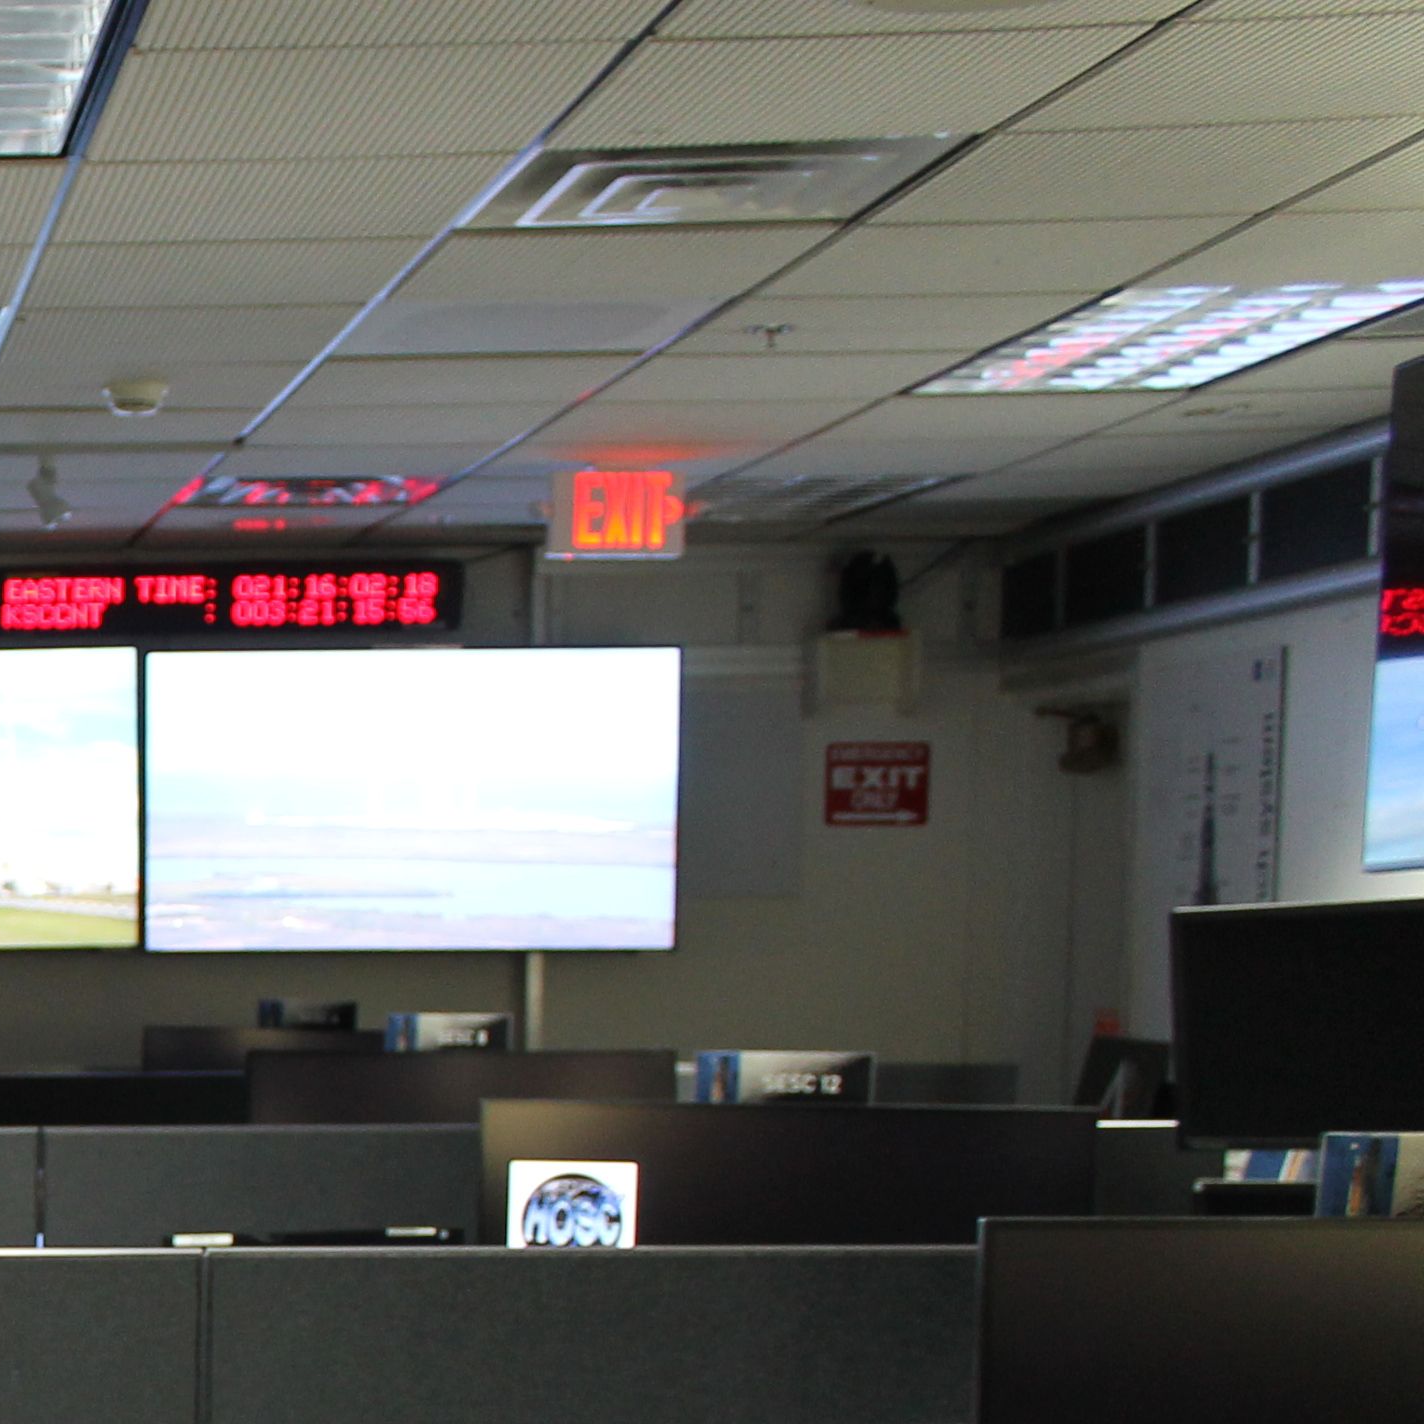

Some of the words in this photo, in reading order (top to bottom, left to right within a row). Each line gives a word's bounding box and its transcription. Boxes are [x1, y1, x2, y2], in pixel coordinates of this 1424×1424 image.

[573, 471, 673, 549] EXIT
[3, 577, 124, 604] EASTERN
[832, 766, 924, 789] EXIT
[762, 1073, 816, 1092] SESC
[523, 1195, 622, 1247] HOSC
